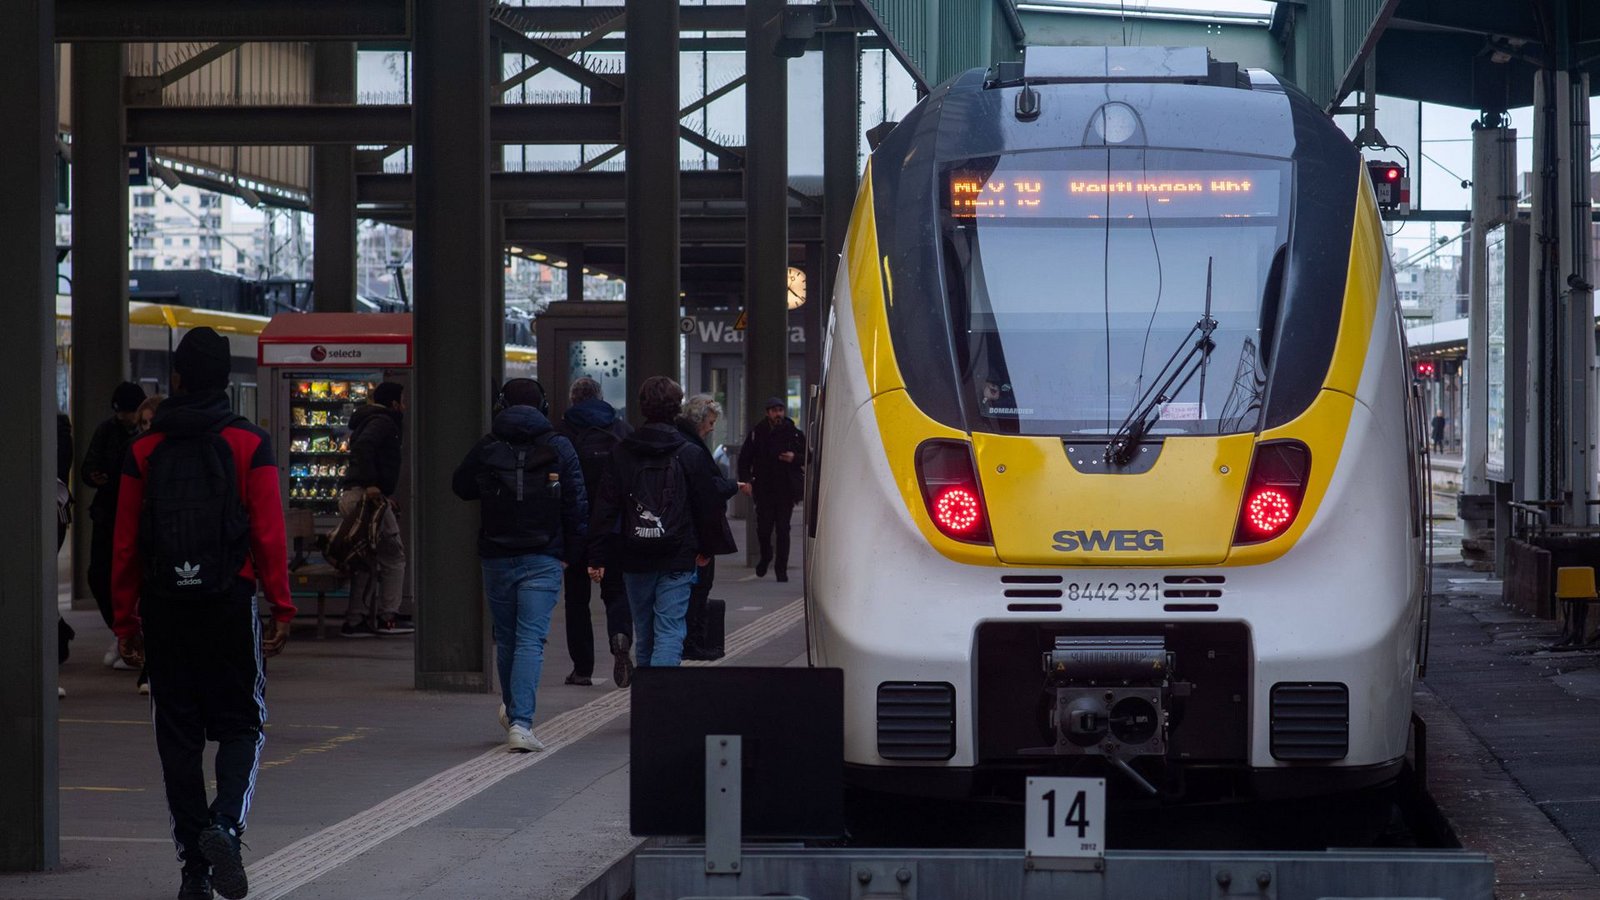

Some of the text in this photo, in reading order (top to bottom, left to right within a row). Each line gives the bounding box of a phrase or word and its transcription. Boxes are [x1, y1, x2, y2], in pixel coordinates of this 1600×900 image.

[328, 349, 362, 358] selecta
[989, 407, 1034, 415] BOMBARDIER
[634, 526, 661, 538] PUMA
[1051, 529, 1164, 552] SWEG
[176, 578, 202, 586] adidas
[1068, 582, 1159, 601] 8442 321
[1042, 789, 1090, 838] 14
[1080, 843, 1097, 851] 2012
